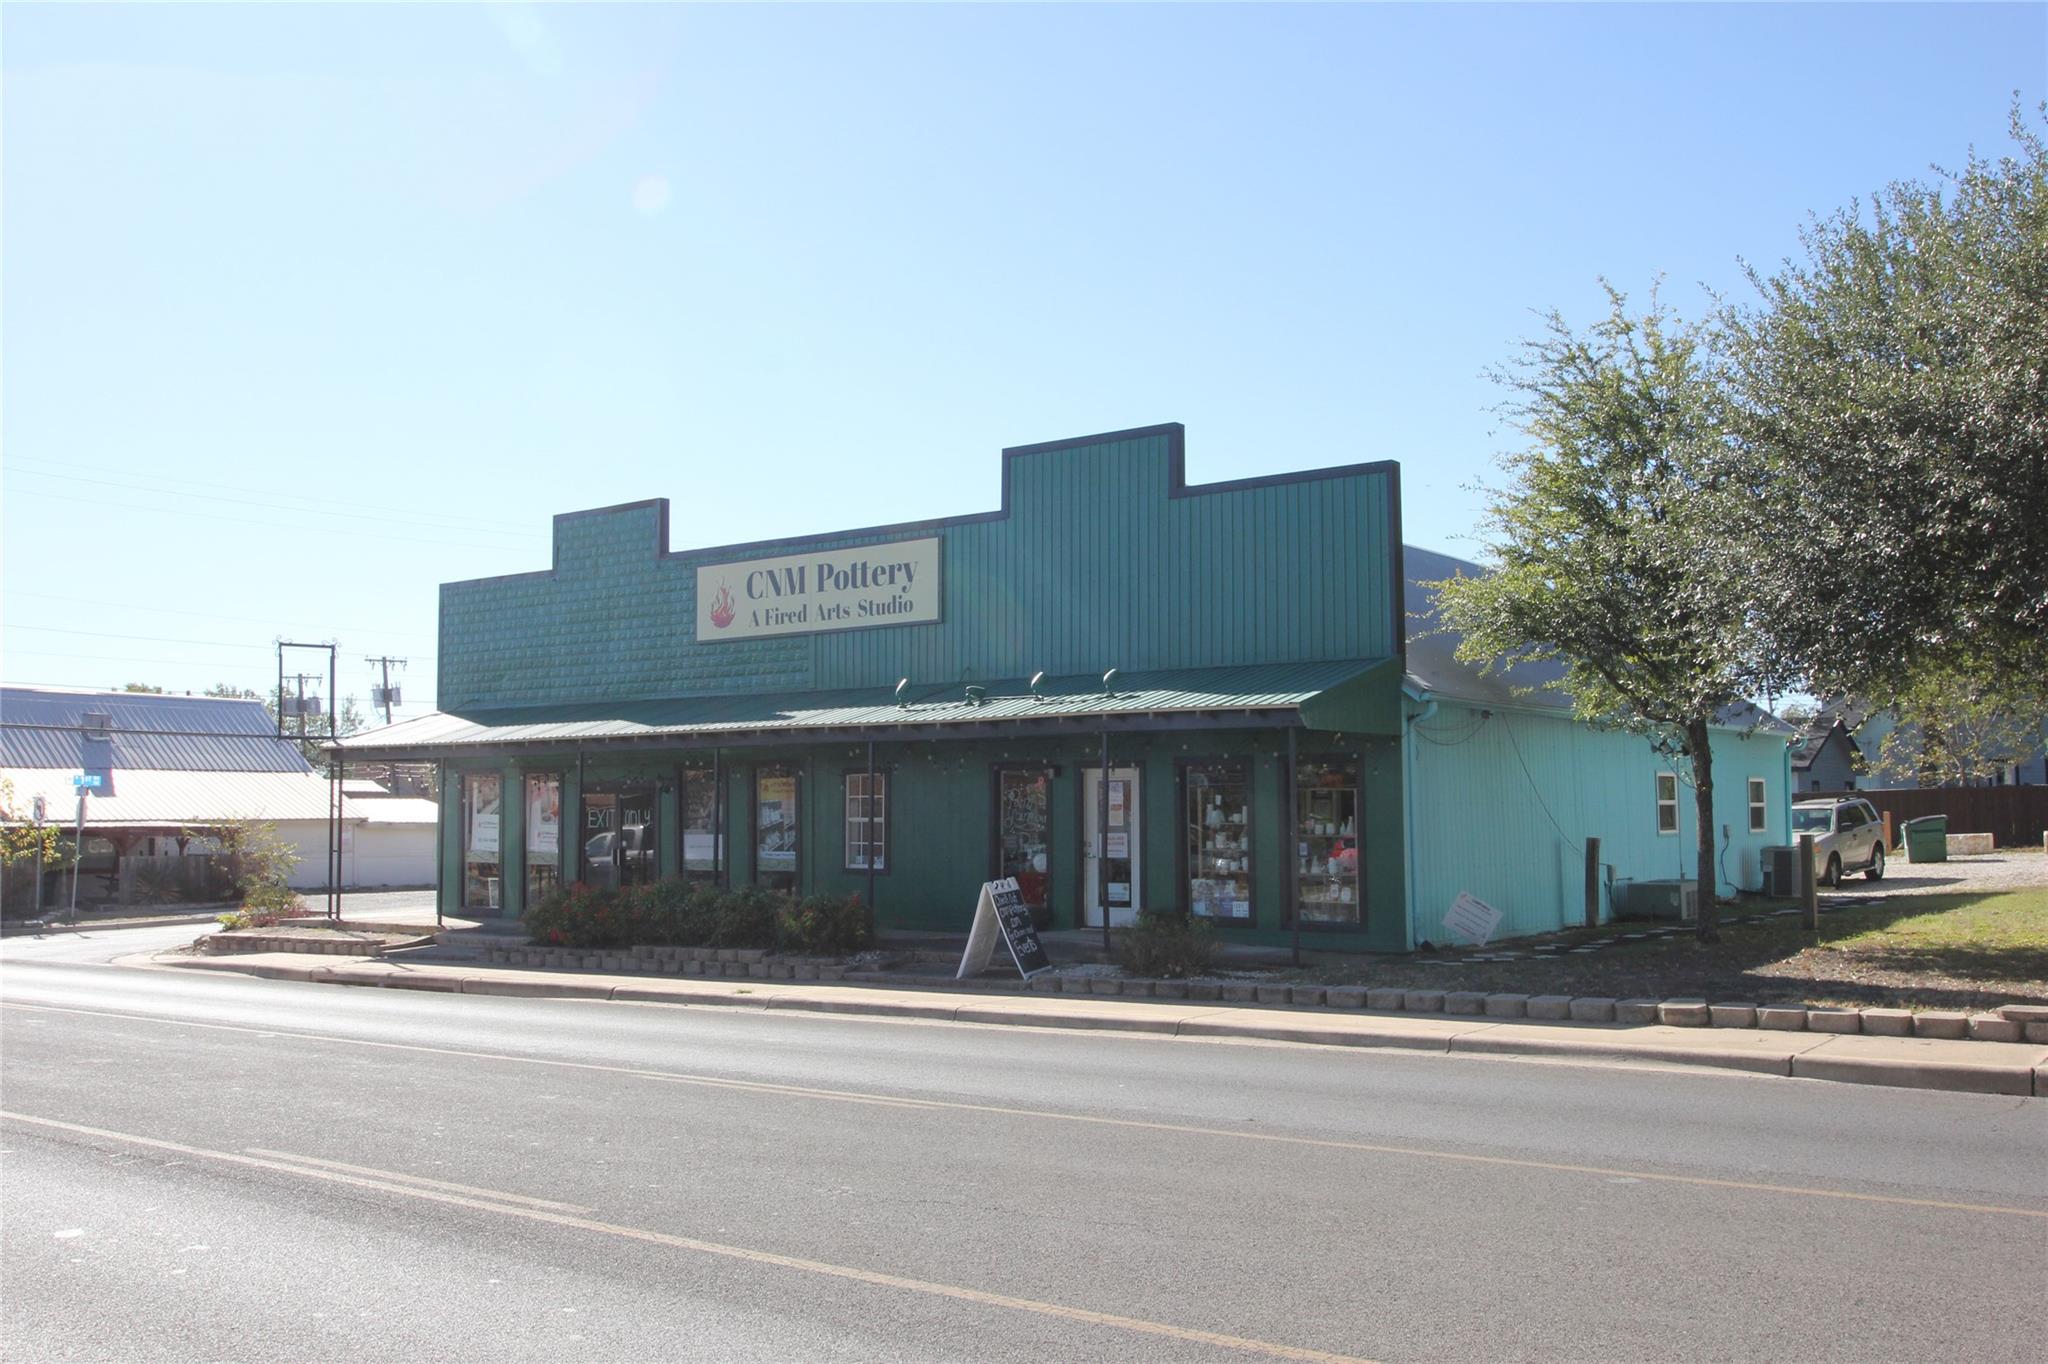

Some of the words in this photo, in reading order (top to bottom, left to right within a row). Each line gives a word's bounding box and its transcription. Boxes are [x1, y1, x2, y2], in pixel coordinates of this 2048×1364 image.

[746, 565, 806, 600] CNM
[817, 559, 918, 593] Pottery
[749, 608, 760, 628] A
[765, 603, 807, 626] Fired
[815, 601, 850, 622] Arts
[857, 595, 914, 618] Studio
[587, 808, 616, 829] EXIT
